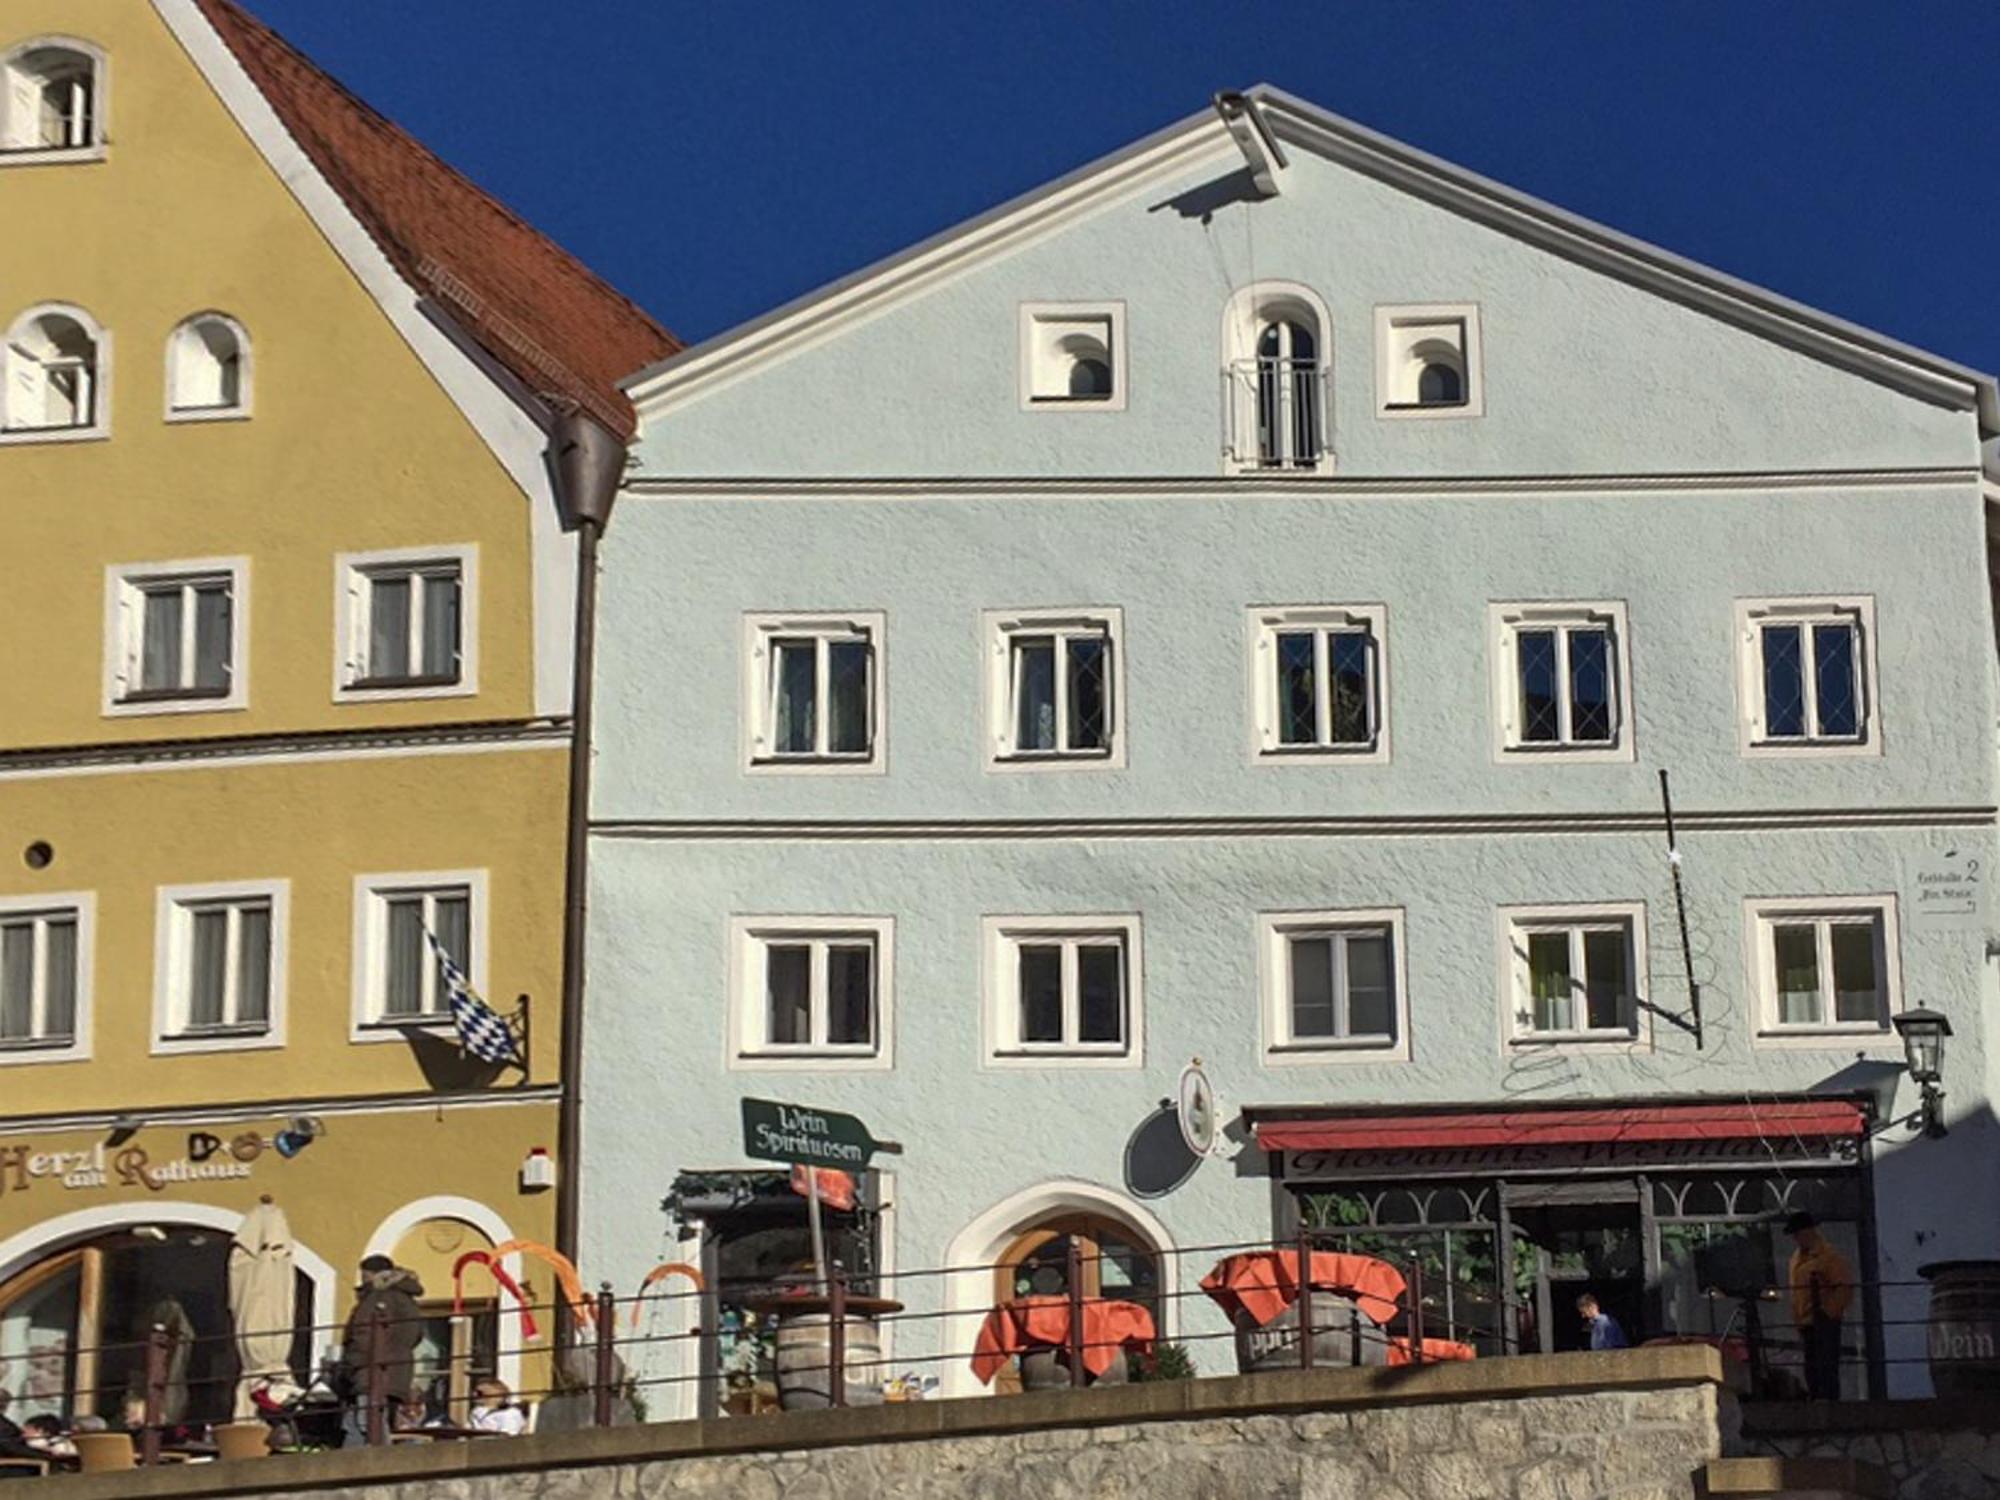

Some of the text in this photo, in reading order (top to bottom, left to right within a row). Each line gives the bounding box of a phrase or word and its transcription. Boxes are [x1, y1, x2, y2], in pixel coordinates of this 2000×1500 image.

[1965, 859, 1979, 883] 2
[777, 1105, 829, 1135] Wein
[756, 1123, 862, 1161] Spirituosen
[114, 1143, 250, 1191] Rathaus
